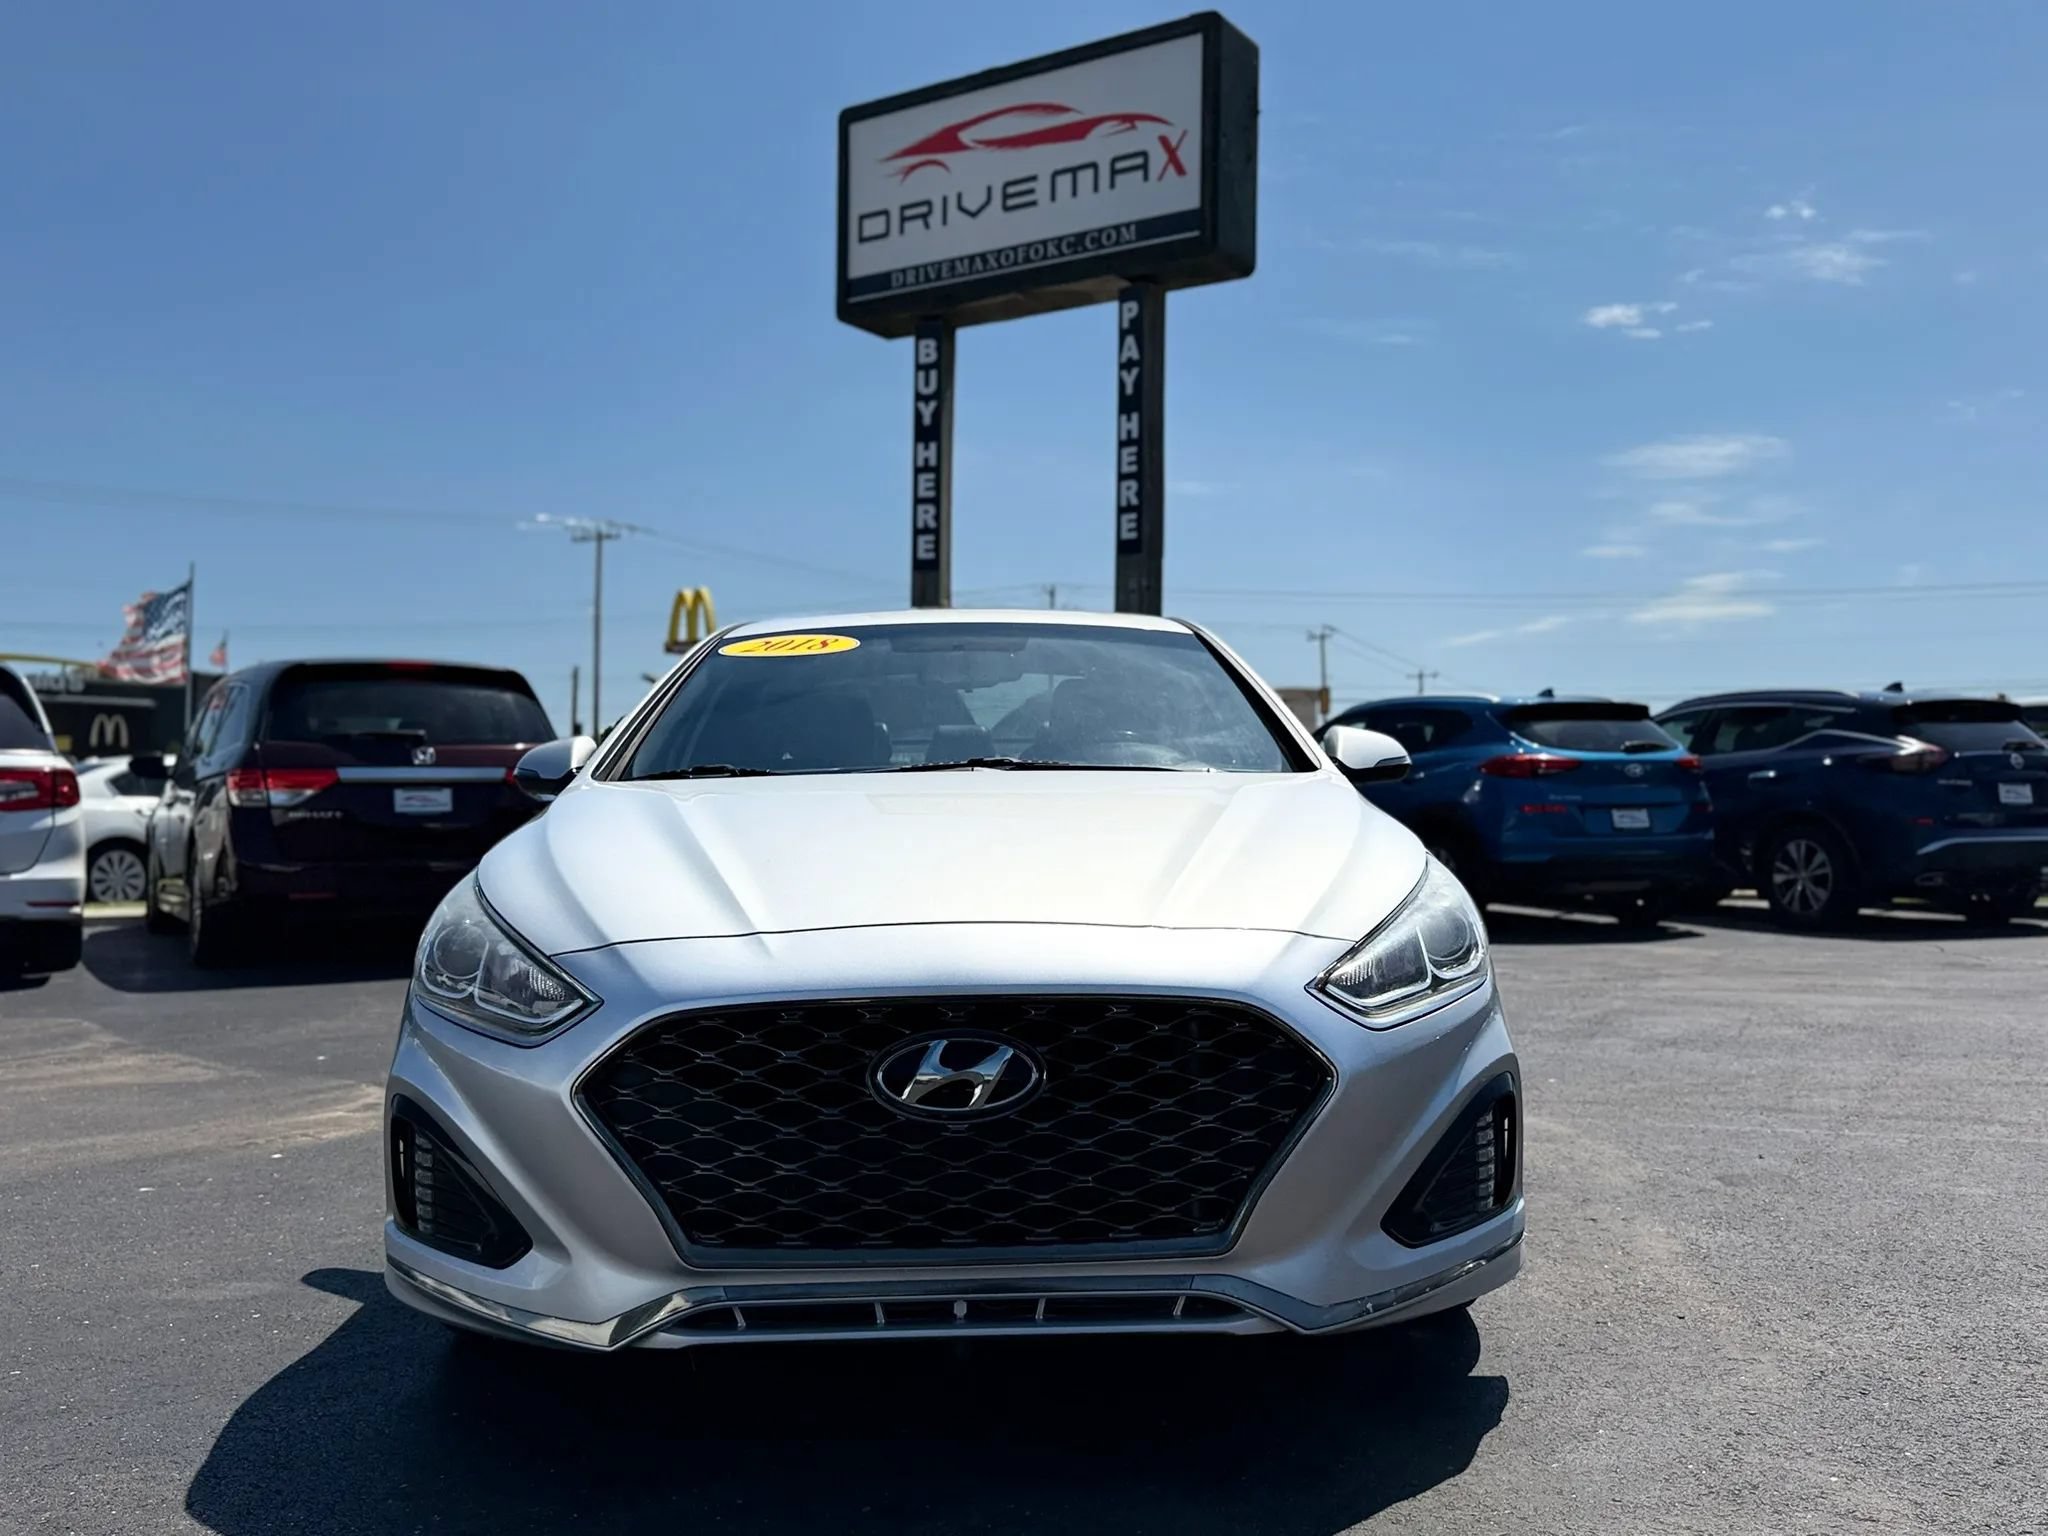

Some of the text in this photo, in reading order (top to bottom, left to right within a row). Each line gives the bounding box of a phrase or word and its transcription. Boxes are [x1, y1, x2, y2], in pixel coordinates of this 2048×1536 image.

[857, 129, 1188, 244] DRIVEMAX
[889, 223, 1137, 289] DRIVEMAXOFOKC.COM
[915, 338, 939, 560] BUY HERE
[1119, 300, 1140, 541] PAY HERE
[740, 638, 840, 653] 2018
